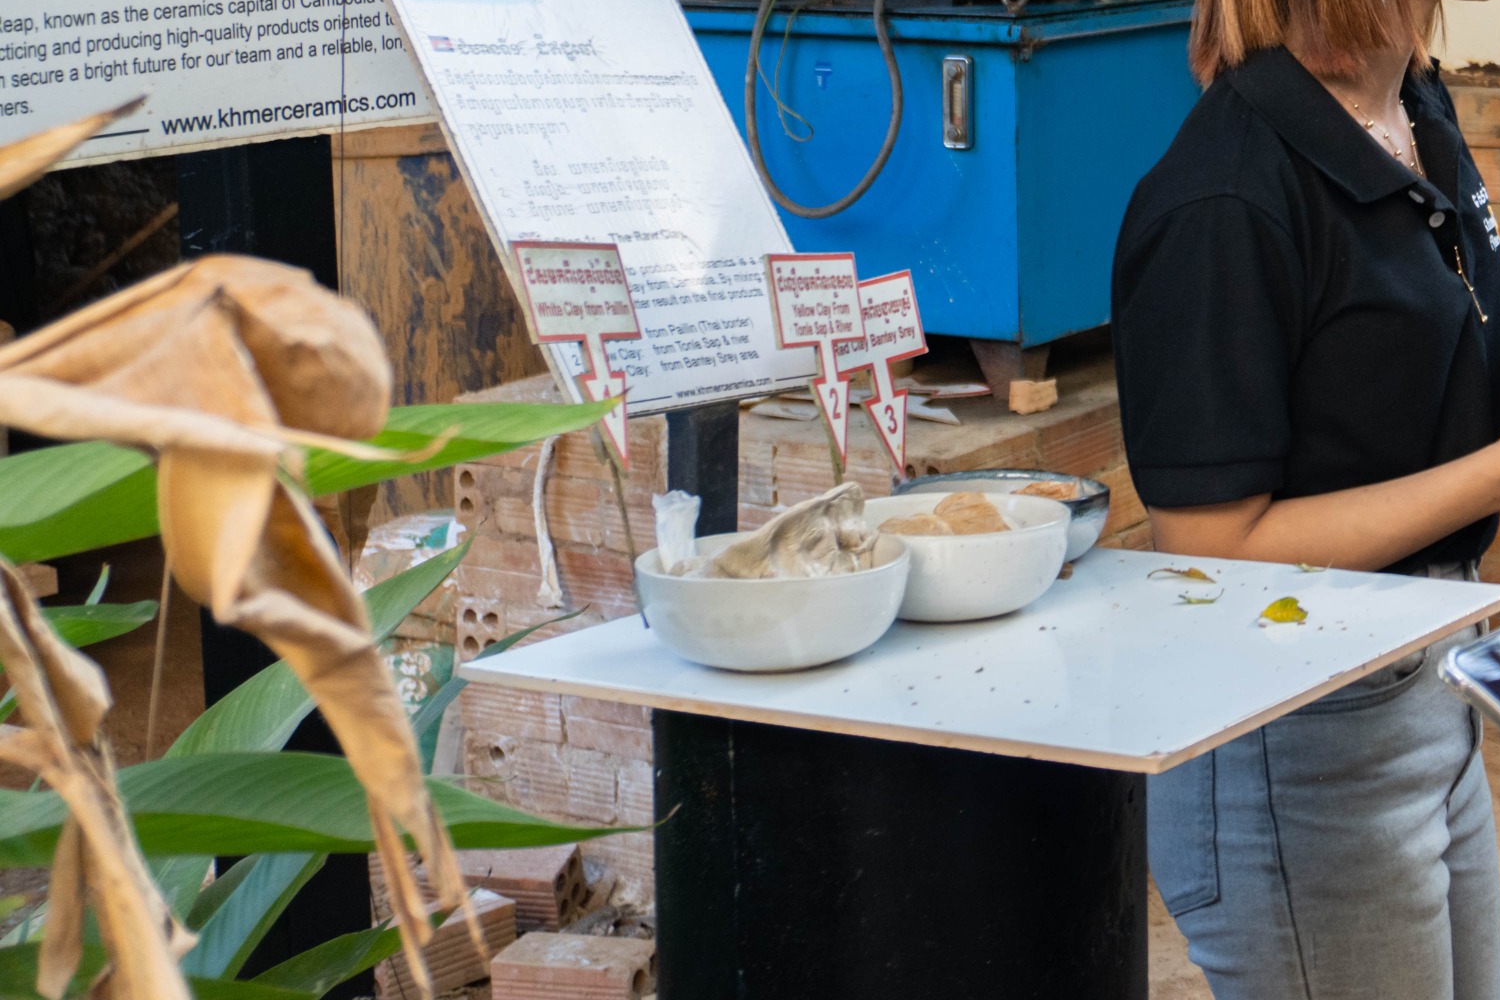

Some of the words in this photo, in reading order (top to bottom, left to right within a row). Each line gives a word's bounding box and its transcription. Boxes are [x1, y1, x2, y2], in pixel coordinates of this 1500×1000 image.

[153, 0, 224, 20] ceramics
[86, 31, 162, 57] producing
[167, 23, 252, 48] high-quality
[257, 18, 319, 41] products
[11, 69, 64, 88] secure
[84, 60, 128, 82] bright
[132, 57, 176, 74] future
[161, 91, 416, 135] www.khmerceramics.com
[646, 279, 669, 291] from
[718, 272, 732, 286] By
[733, 271, 762, 283] mixing
[537, 301, 563, 317] White
[564, 301, 583, 320] Clay
[584, 301, 604, 316] from
[652, 294, 679, 307] result
[679, 295, 691, 305] on
[692, 292, 707, 302] the
[707, 289, 726, 301] final
[792, 303, 815, 318] Yellow
[816, 302, 831, 319] Clay
[832, 301, 850, 315] From
[645, 327, 669, 340] from
[698, 319, 721, 334] (Thai
[721, 316, 754, 330] border)
[814, 321, 827, 337] Sap
[829, 320, 834, 333] &
[835, 319, 852, 333] River
[835, 341, 849, 357] Red
[851, 338, 868, 354] Clay
[898, 325, 915, 340] Srey
[619, 347, 644, 362] Clay:
[652, 343, 675, 357] from
[675, 339, 702, 353] Tonle
[703, 336, 722, 351] Sap
[724, 335, 731, 346] &
[731, 334, 750, 346] river
[626, 364, 650, 378] Clay:
[660, 359, 684, 373] from
[719, 351, 738, 365] Srey
[740, 350, 759, 360] area
[676, 376, 772, 400] www.khmerceramics.com
[829, 388, 842, 420] 2
[884, 404, 897, 435] 3
